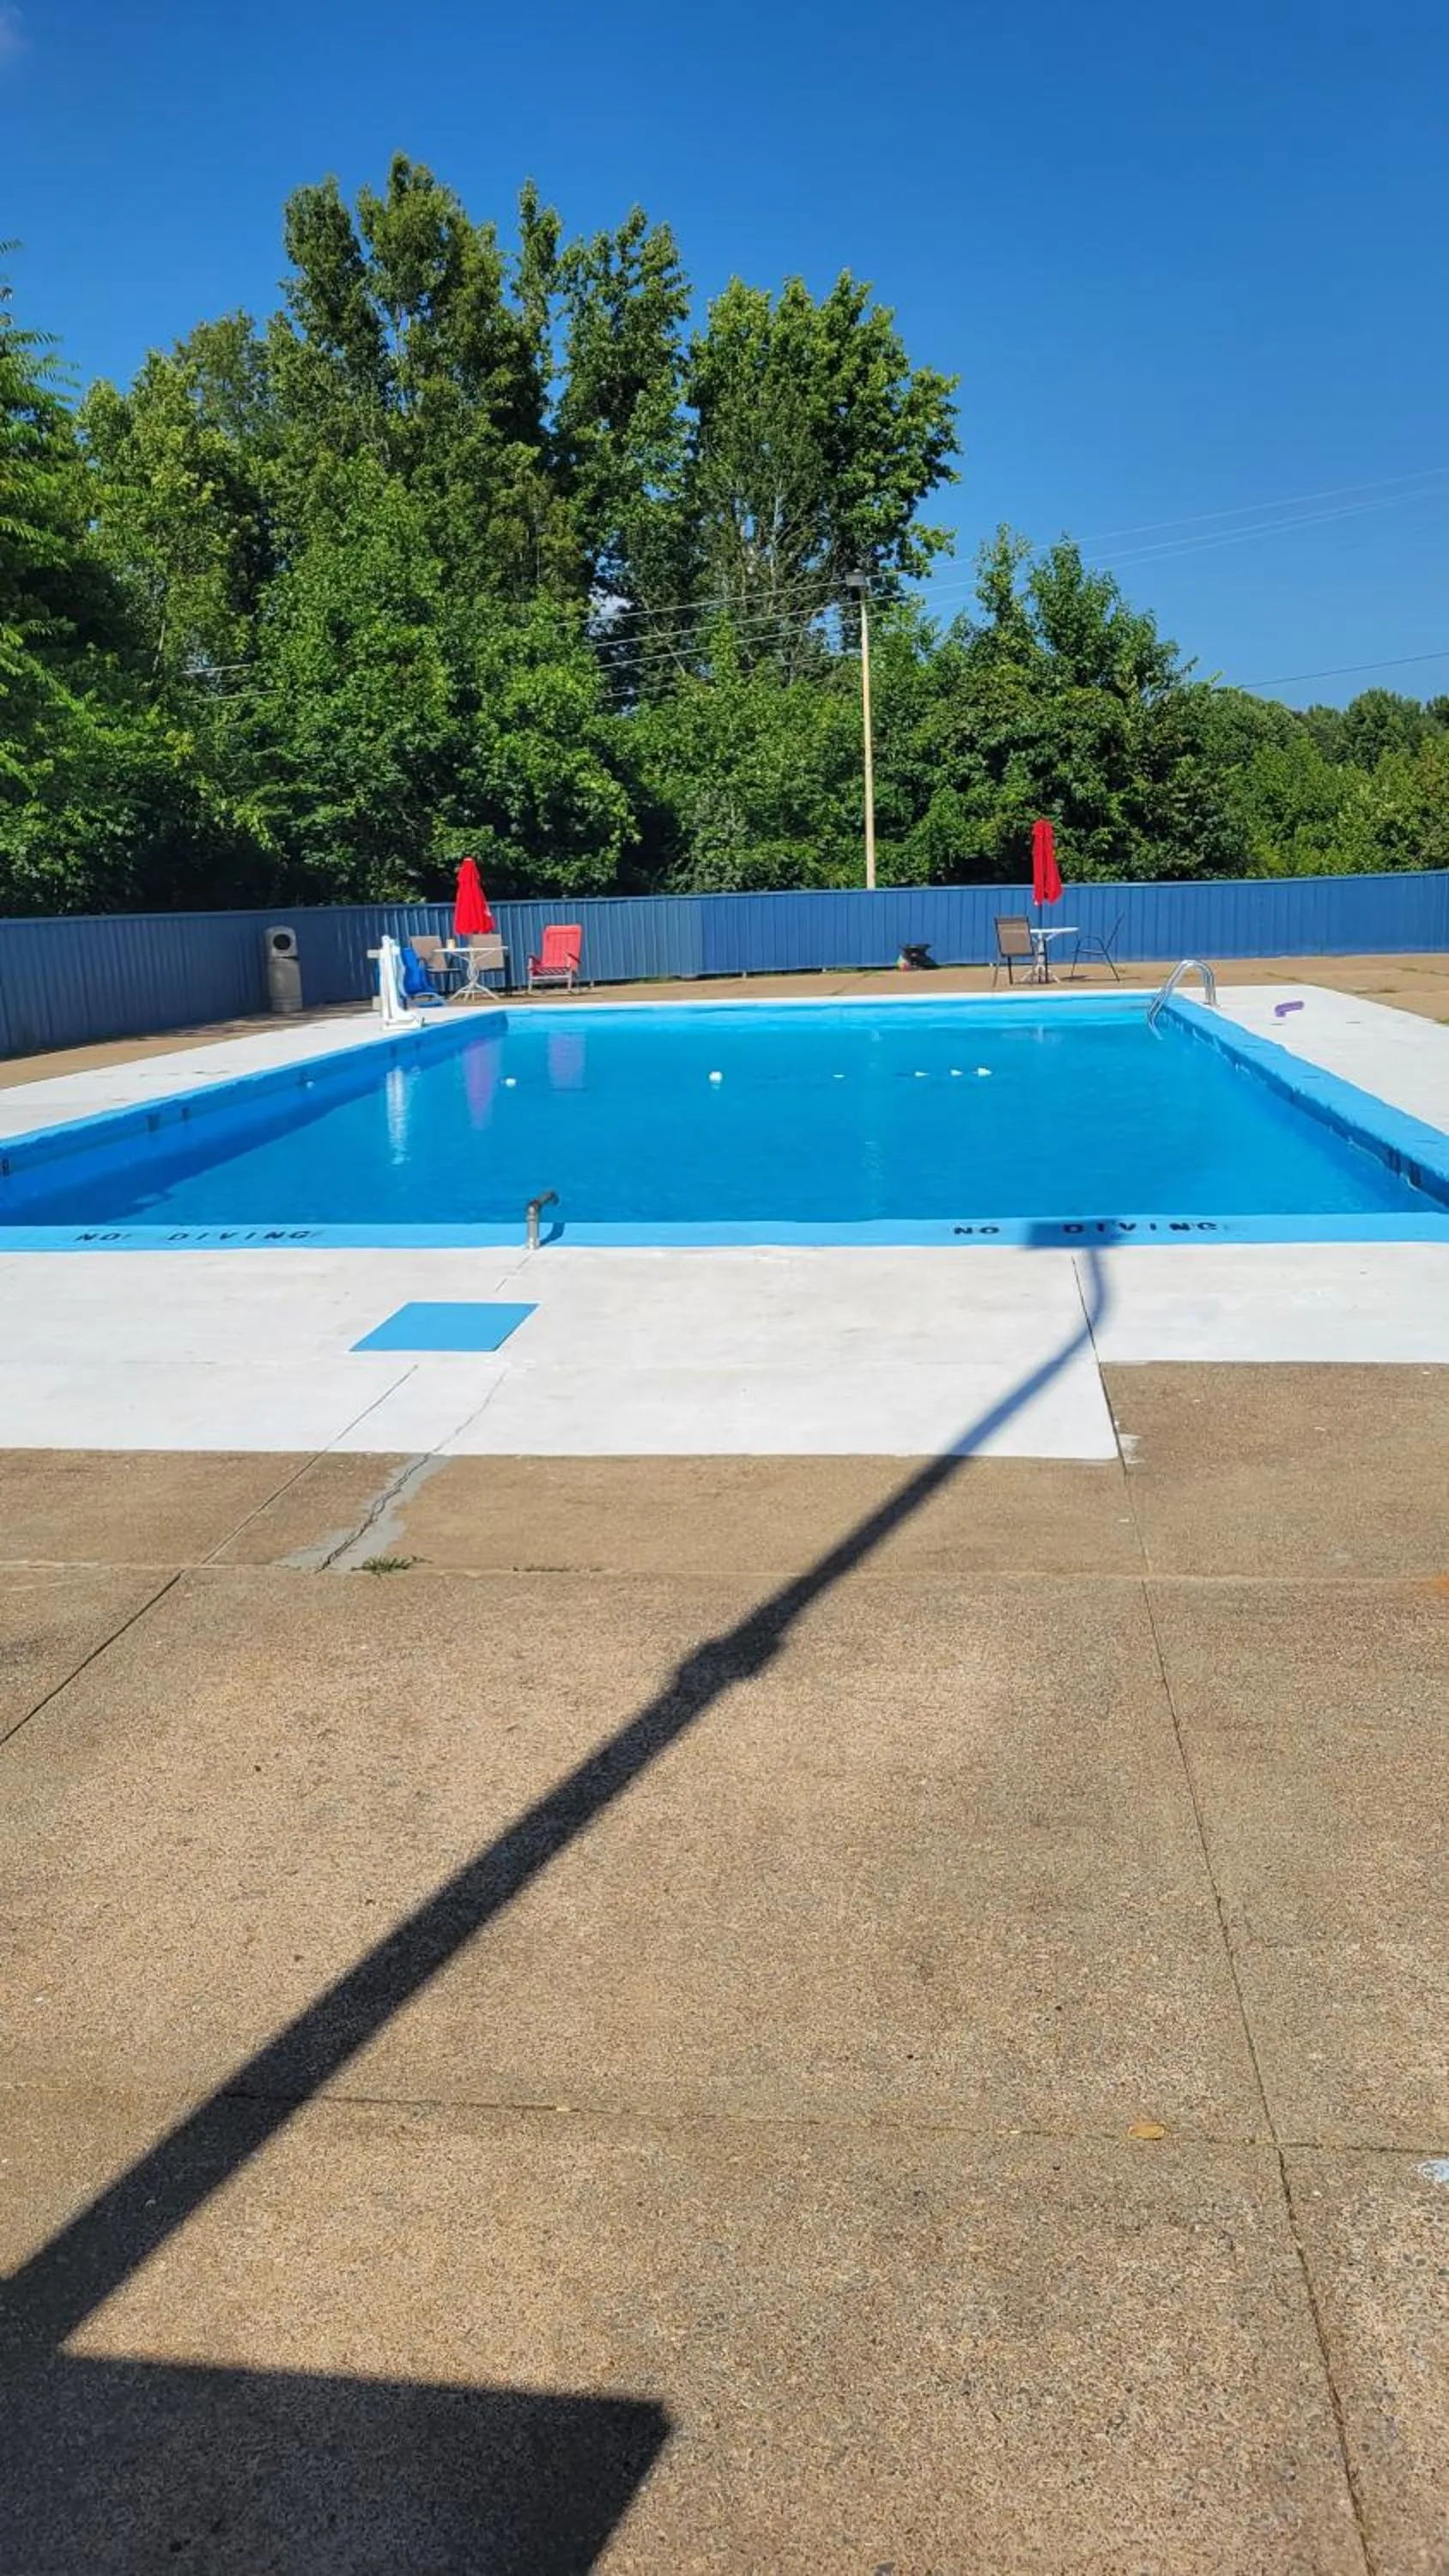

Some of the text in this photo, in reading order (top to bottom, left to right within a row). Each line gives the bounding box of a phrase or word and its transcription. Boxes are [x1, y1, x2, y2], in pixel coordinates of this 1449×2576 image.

[953, 1222, 1217, 1235] NO DIVING
[75, 1230, 312, 1242] NO DIVING
